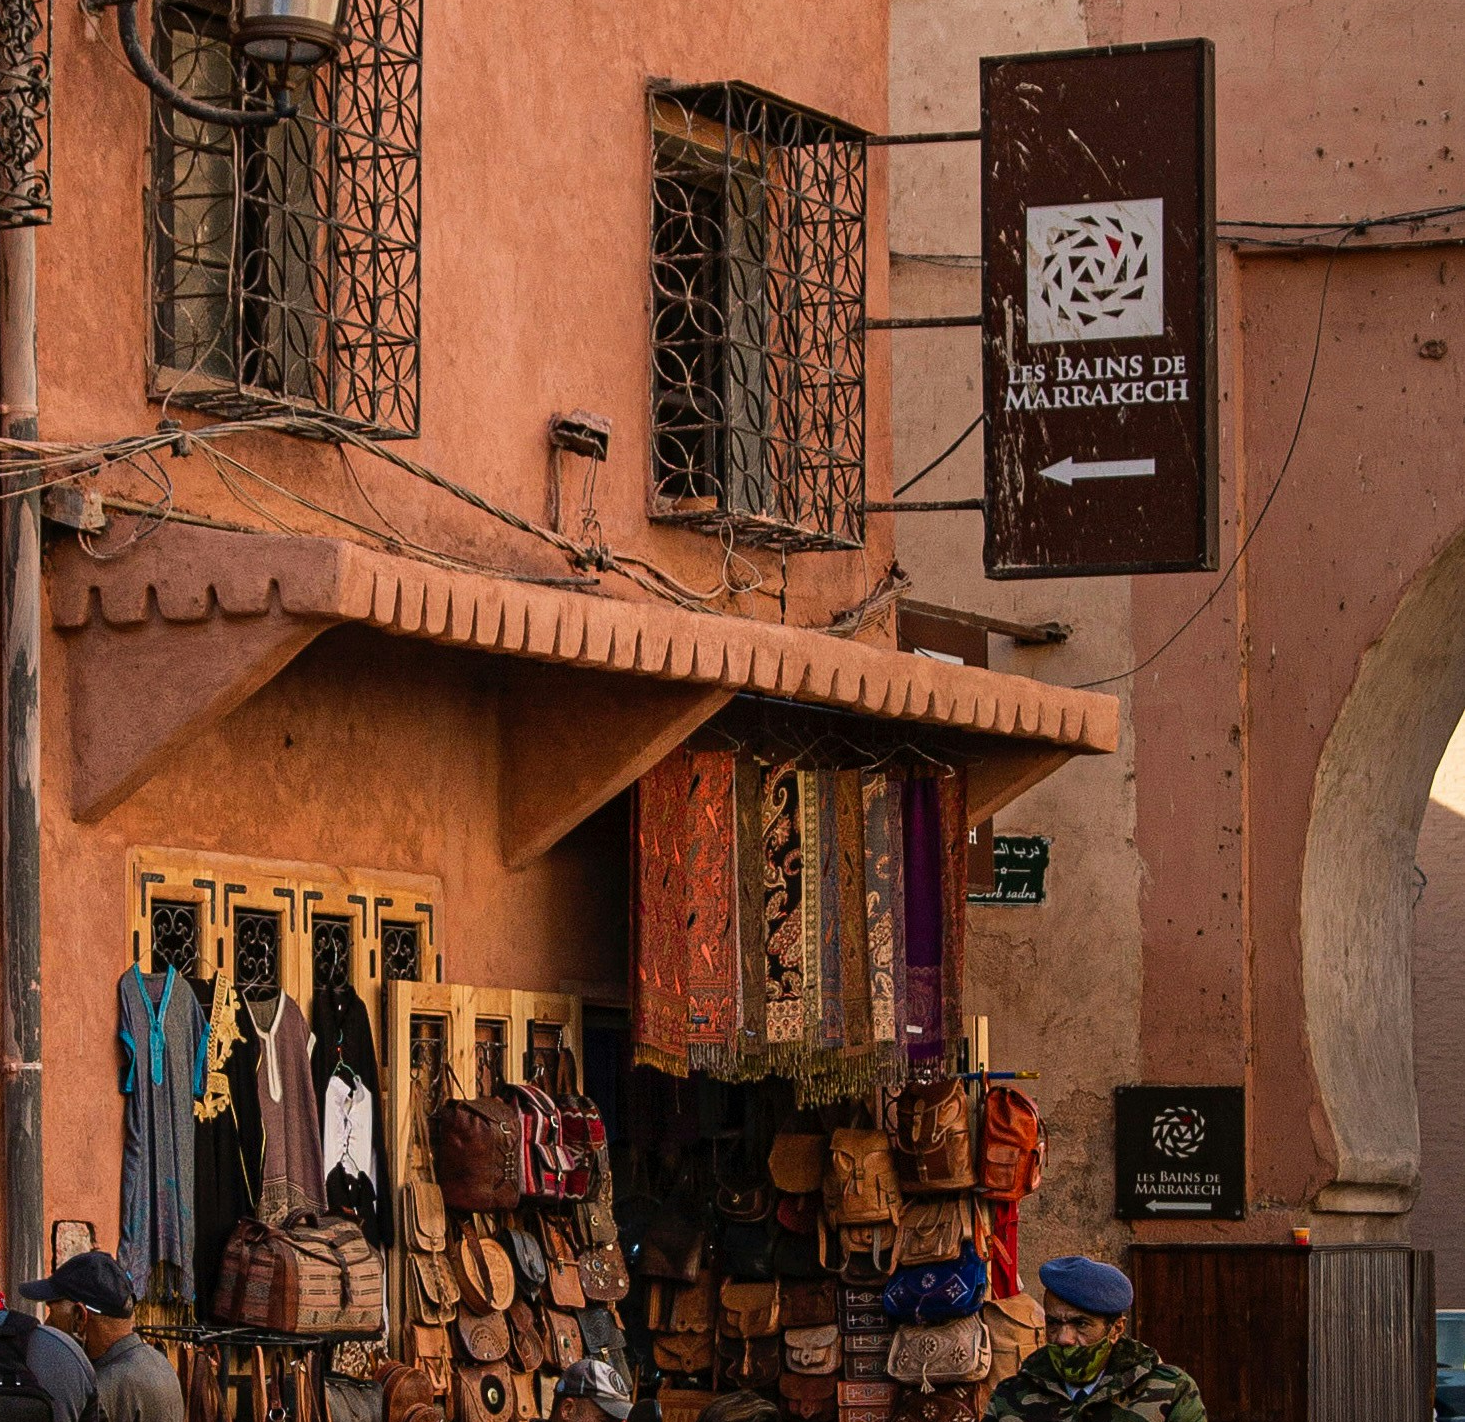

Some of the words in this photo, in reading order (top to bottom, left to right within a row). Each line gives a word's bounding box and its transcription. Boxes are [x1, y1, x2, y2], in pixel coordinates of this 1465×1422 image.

[1008, 364, 1046, 384] LES
[1056, 355, 1143, 381] BAINS
[1153, 356, 1186, 375] DE
[1004, 379, 1189, 411] MARRAKECH
[1006, 882, 1037, 899] sadra
[1137, 1173, 1156, 1182] LES
[1160, 1170, 1201, 1183] BAINS
[1205, 1174, 1221, 1183] DE
[1135, 1183, 1221, 1196] MARRAKECH
